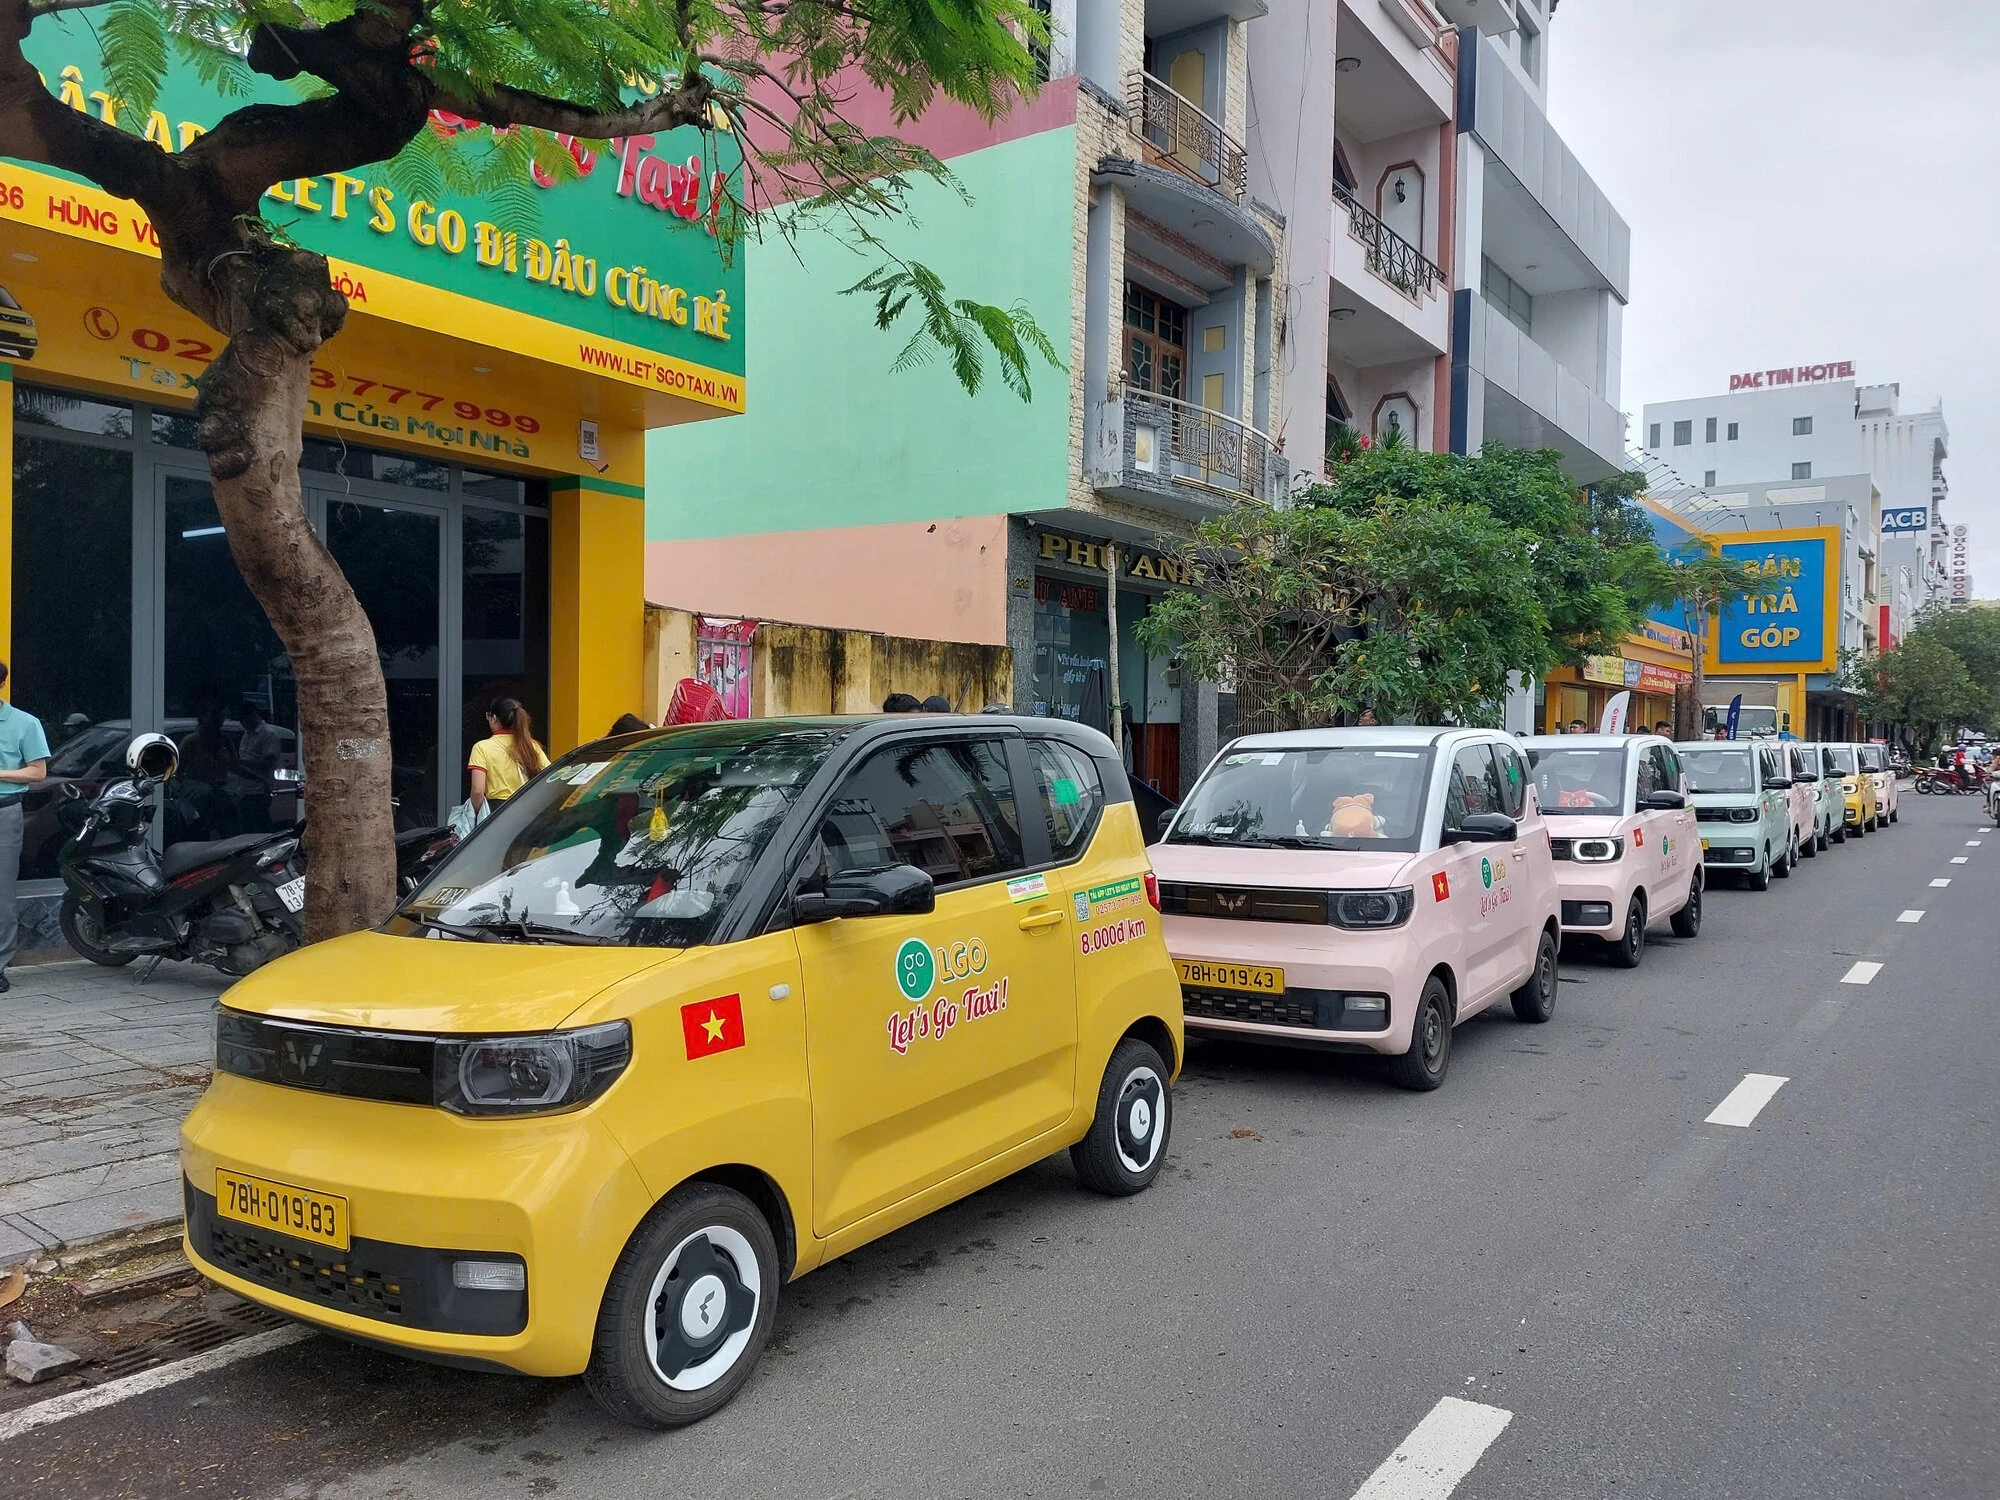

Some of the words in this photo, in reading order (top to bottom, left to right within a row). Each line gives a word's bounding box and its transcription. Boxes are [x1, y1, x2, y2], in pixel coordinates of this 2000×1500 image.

[48, 195, 119, 235] HÙNG
[407, 200, 467, 255] GO
[474, 221, 518, 274] ĐI
[524, 238, 597, 297] ĐÂU
[605, 265, 688, 327] CŨNG
[693, 289, 731, 341] RẺ
[1766, 367, 1794, 386] TIN
[1797, 360, 1855, 382] HOTEL
[120, 355, 199, 390] Tax
[334, 401, 399, 432] Của
[407, 416, 463, 446] Mọi
[469, 429, 530, 458] Nhà
[1881, 510, 1926, 529] ACB
[1743, 586, 1798, 614] TRẢ
[1740, 622, 1800, 648] GÓP
[432, 887, 468, 905] TAXI
[936, 937, 988, 984] LGO
[1182, 964, 1274, 988] 78H-019.43
[888, 1004, 929, 1055] Let's
[933, 996, 959, 1041] Go
[226, 1180, 335, 1237] 78H-019.83
